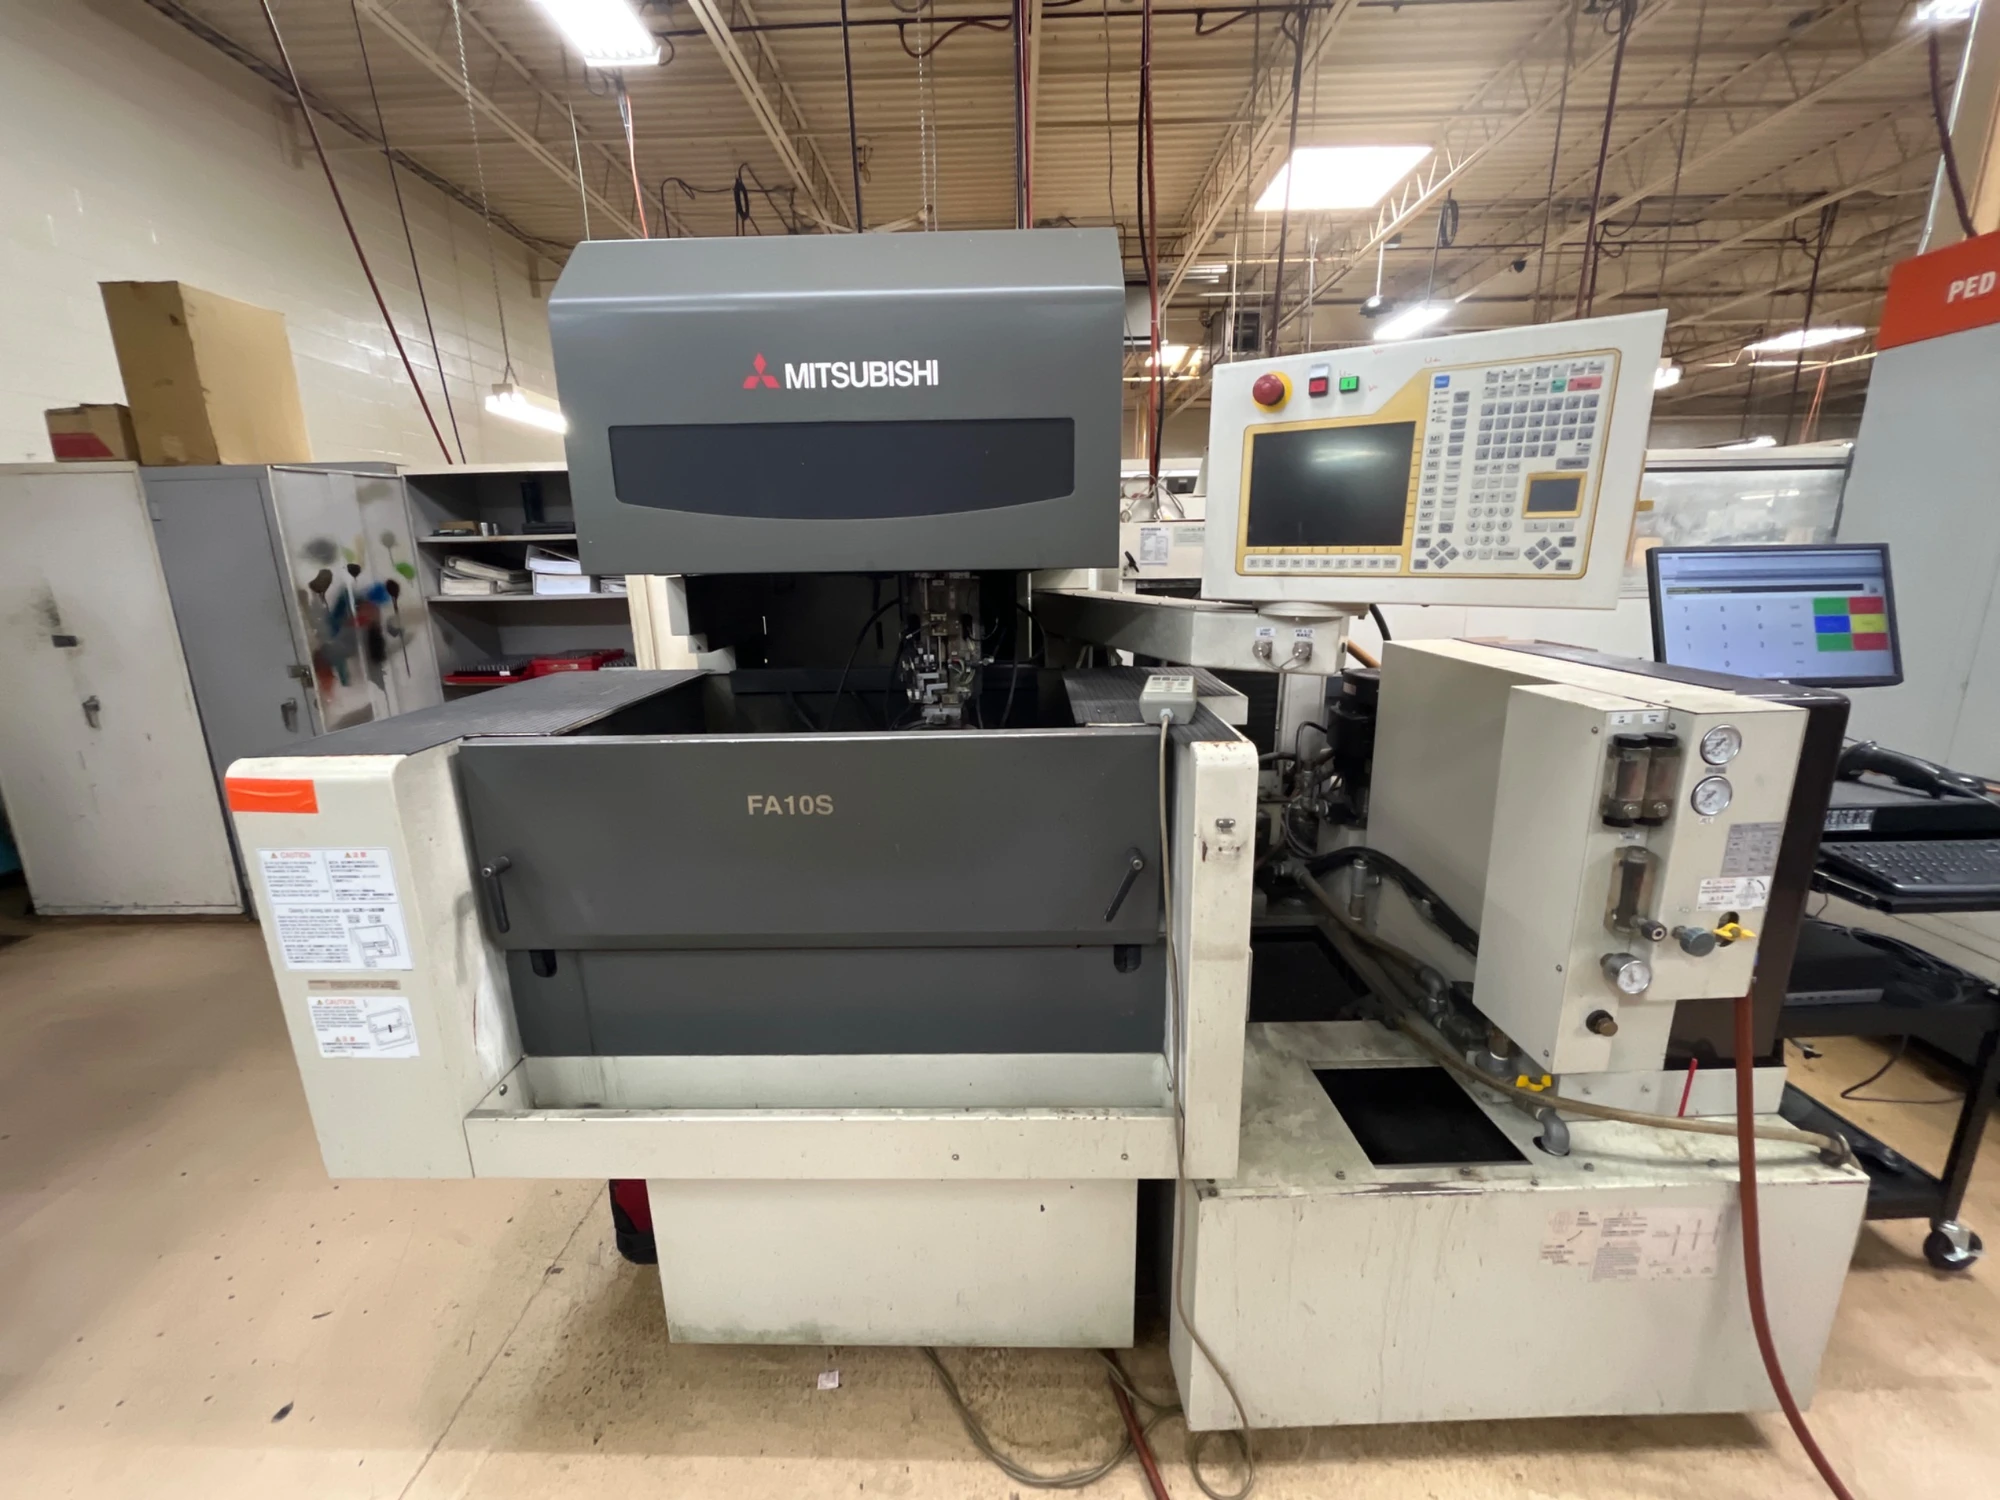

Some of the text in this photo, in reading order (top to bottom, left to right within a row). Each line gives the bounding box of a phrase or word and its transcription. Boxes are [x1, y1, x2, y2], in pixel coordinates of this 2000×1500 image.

[1947, 271, 1996, 304] PED
[784, 359, 939, 389] MITSUBISHI
[747, 794, 834, 815] FA10S
